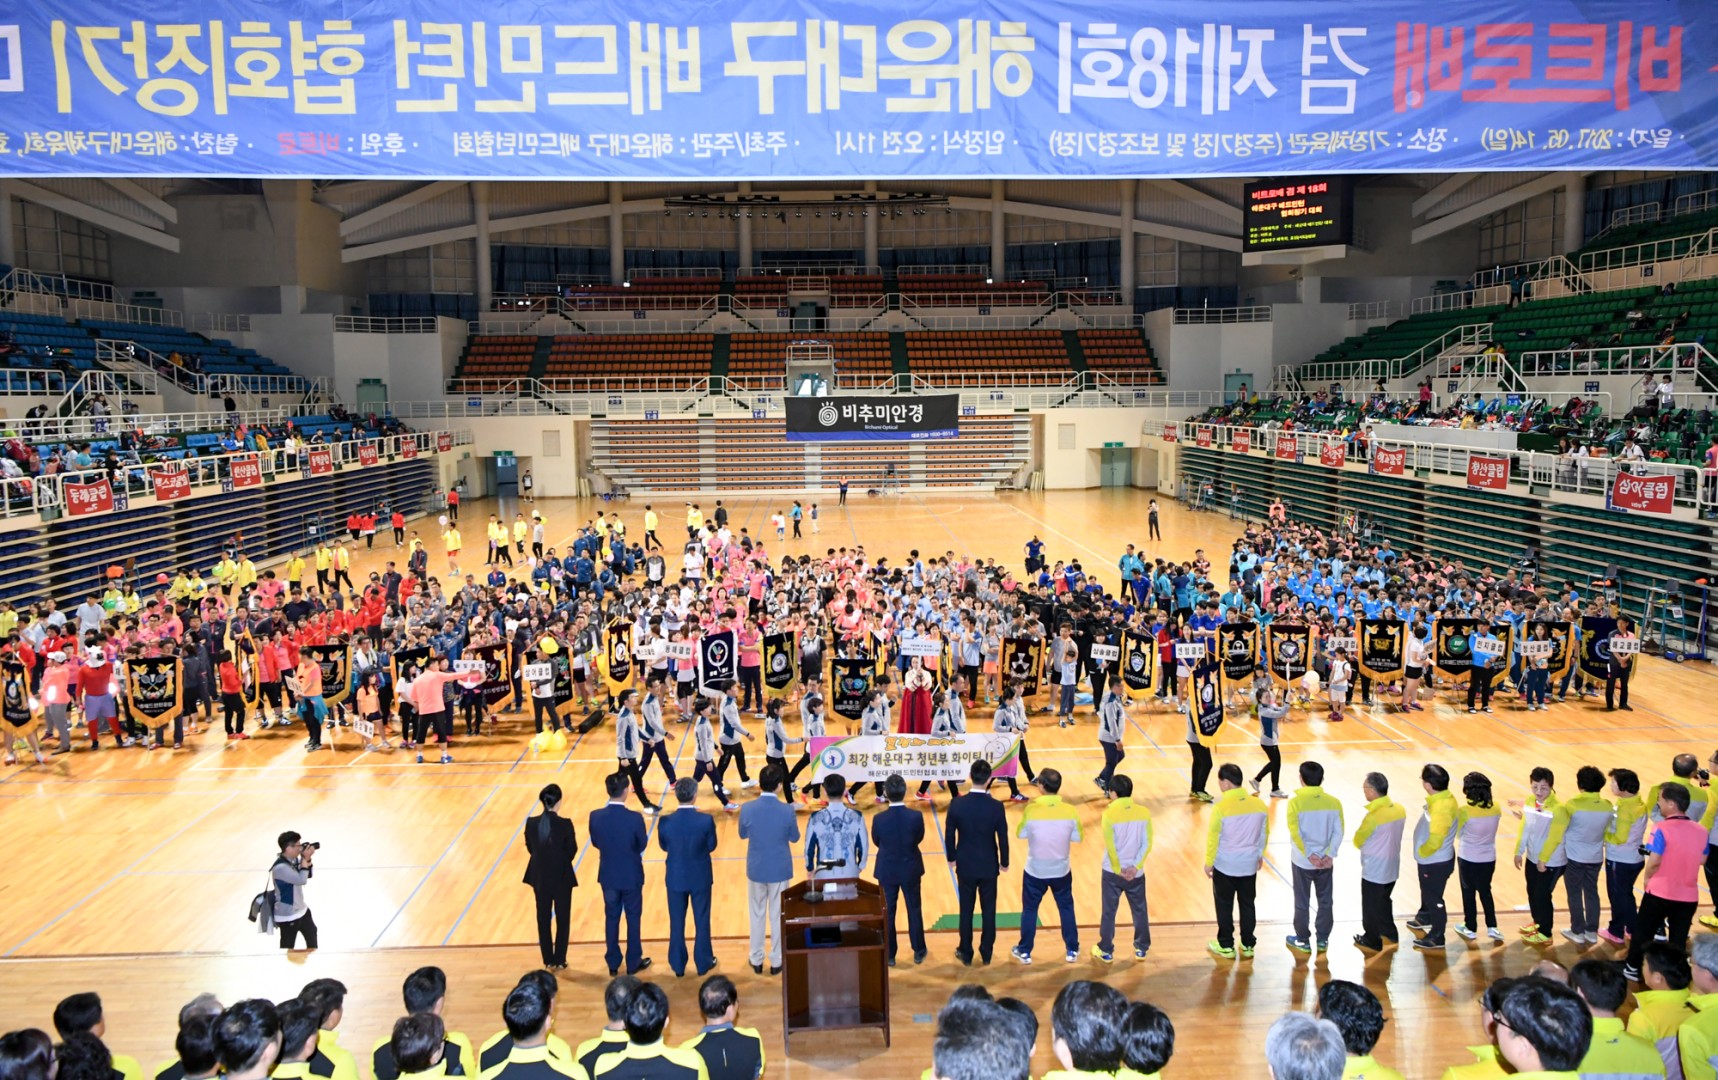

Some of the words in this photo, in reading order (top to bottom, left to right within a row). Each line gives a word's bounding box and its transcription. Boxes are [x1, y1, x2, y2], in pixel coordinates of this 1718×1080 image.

[842, 404, 924, 423] 비추미안경
[1618, 480, 1668, 500] 삼어클럽
[114, 499, 126, 511] 1-3
[848, 754, 869, 766] 최강
[872, 752, 914, 765] 해운대구
[917, 752, 948, 765] 청년부
